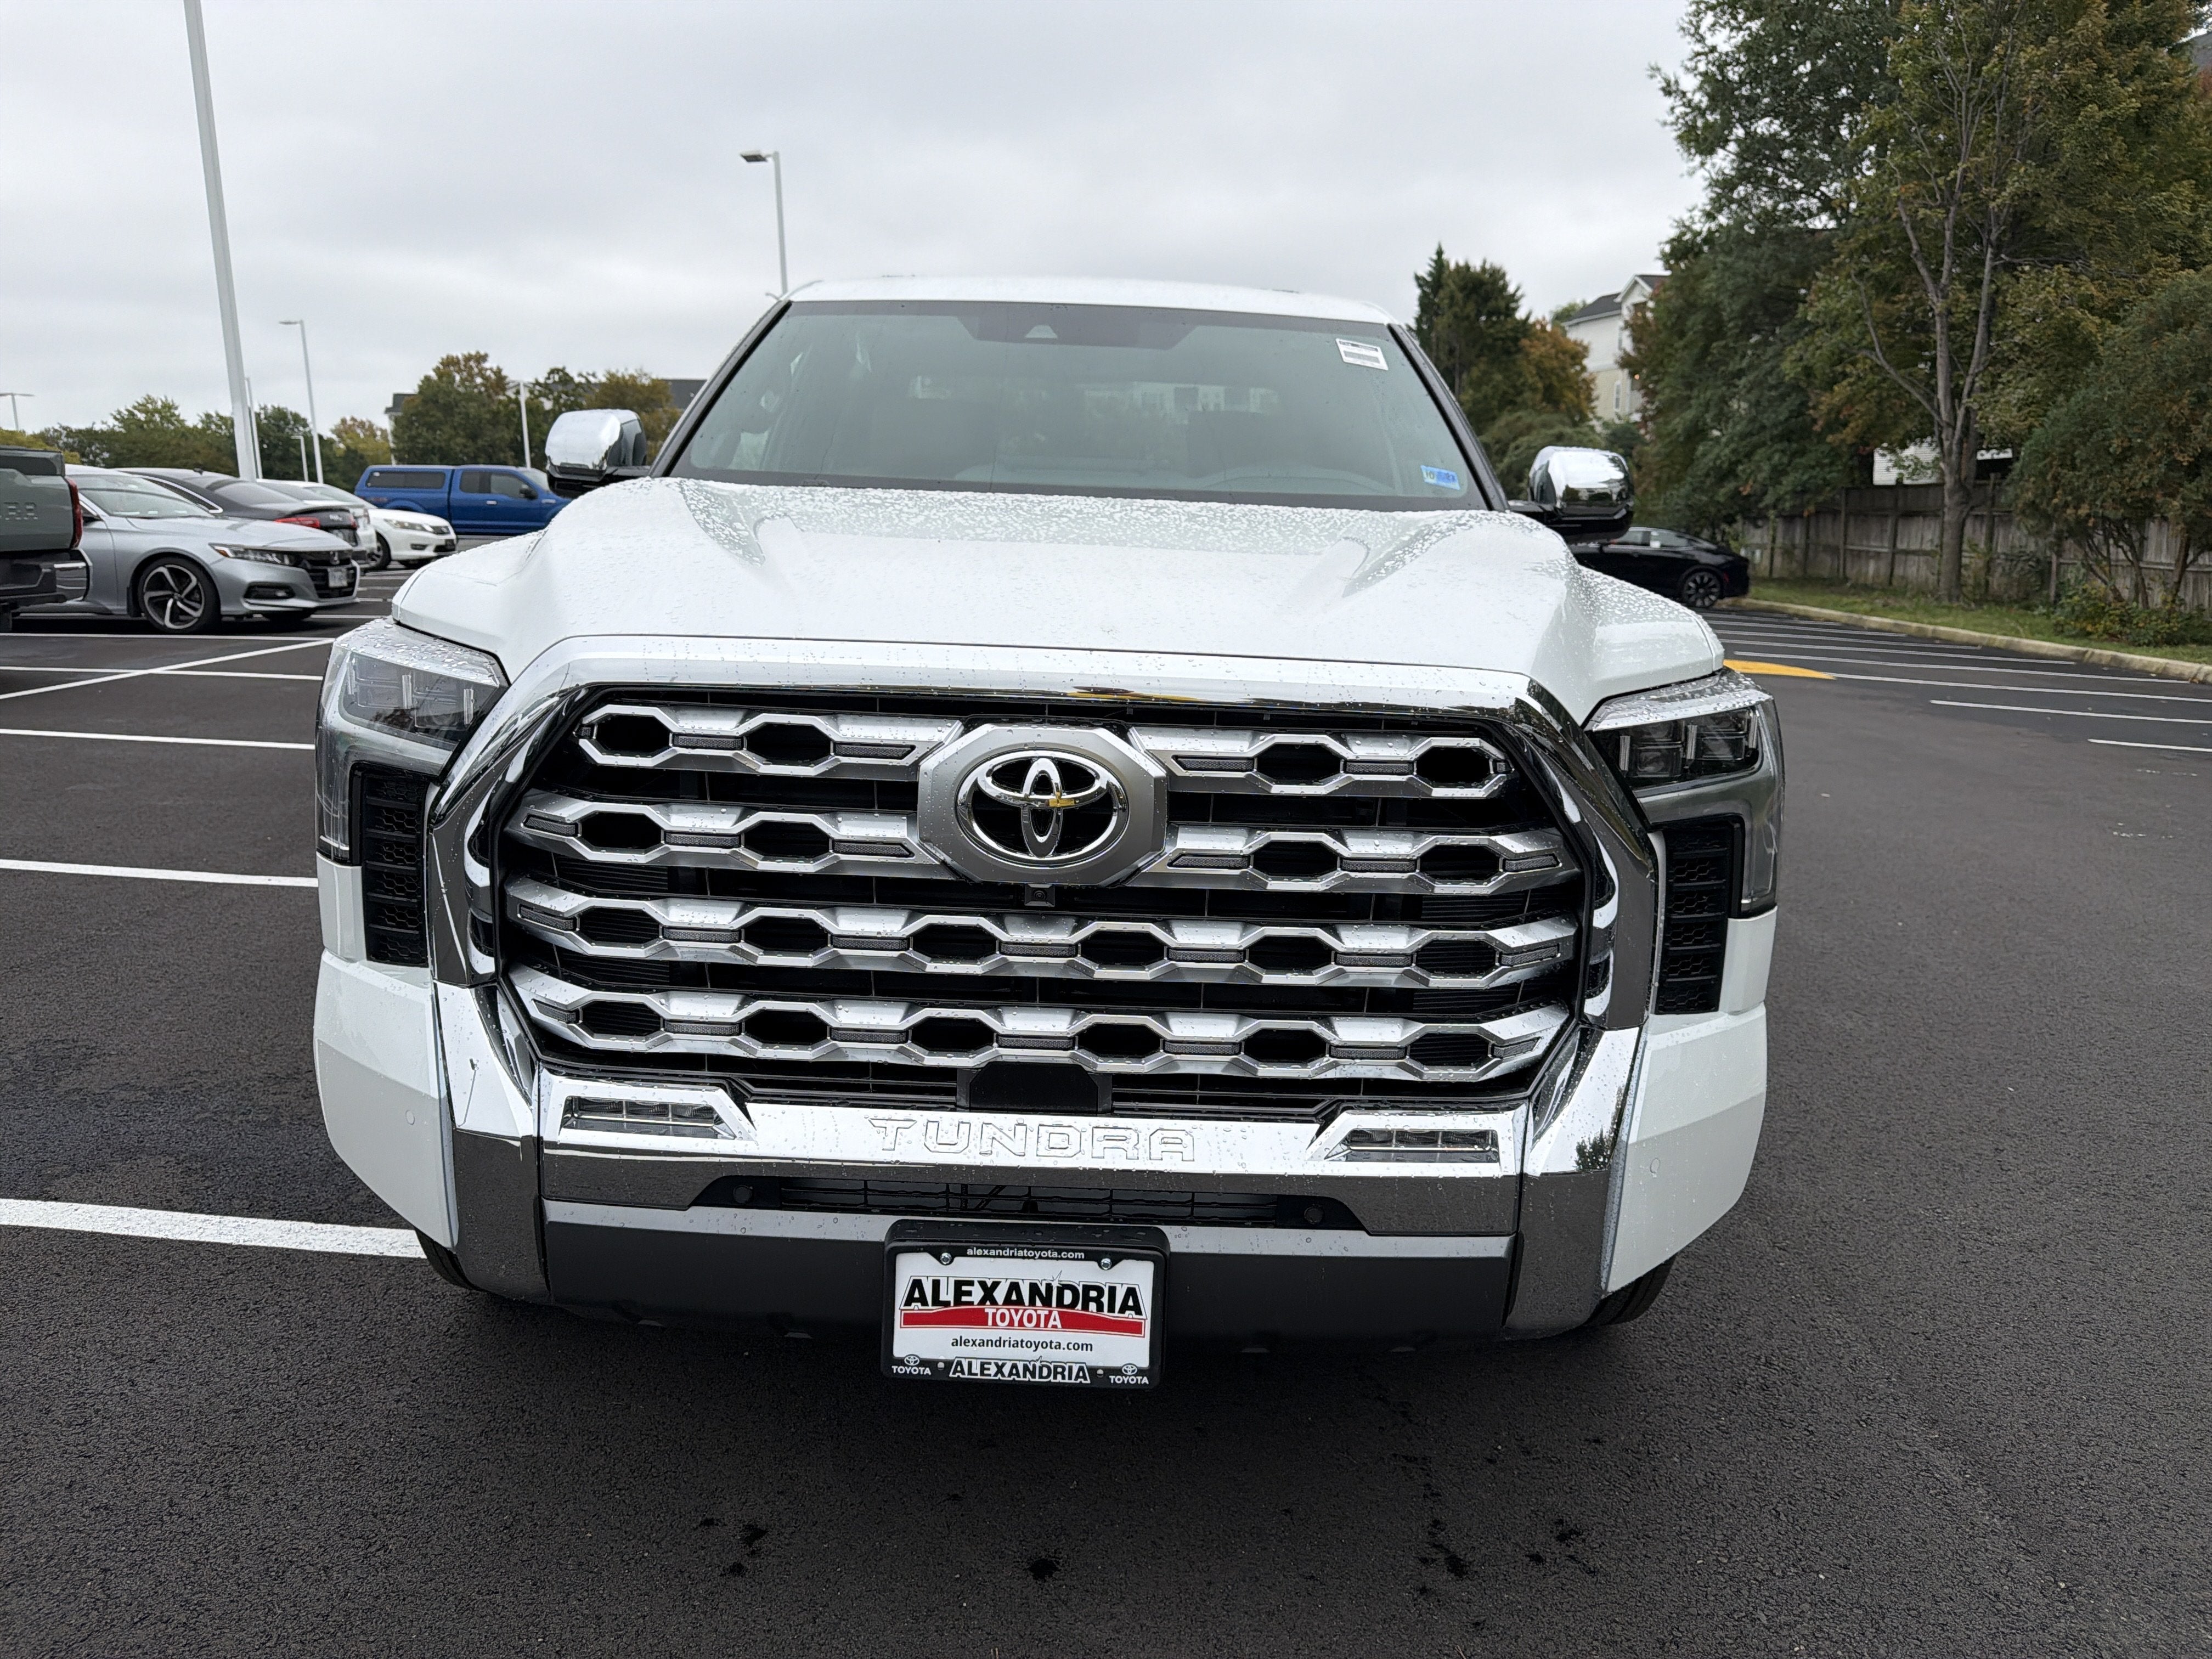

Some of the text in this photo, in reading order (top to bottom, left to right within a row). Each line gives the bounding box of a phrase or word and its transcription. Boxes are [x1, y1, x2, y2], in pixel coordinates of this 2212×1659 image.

[868, 1118, 1195, 1162] TUNDRA
[967, 1246, 1085, 1259] alexandriatoyota.com
[903, 1278, 1143, 1316] ALEXANDRIA
[984, 1308, 1062, 1329] TOYOTA
[951, 1335, 1093, 1352] alexandriatoyota.com
[891, 1365, 932, 1375] TOYOTA
[950, 1358, 1090, 1384] ALEXANDRIA
[1109, 1375, 1149, 1385] TOYOTA
